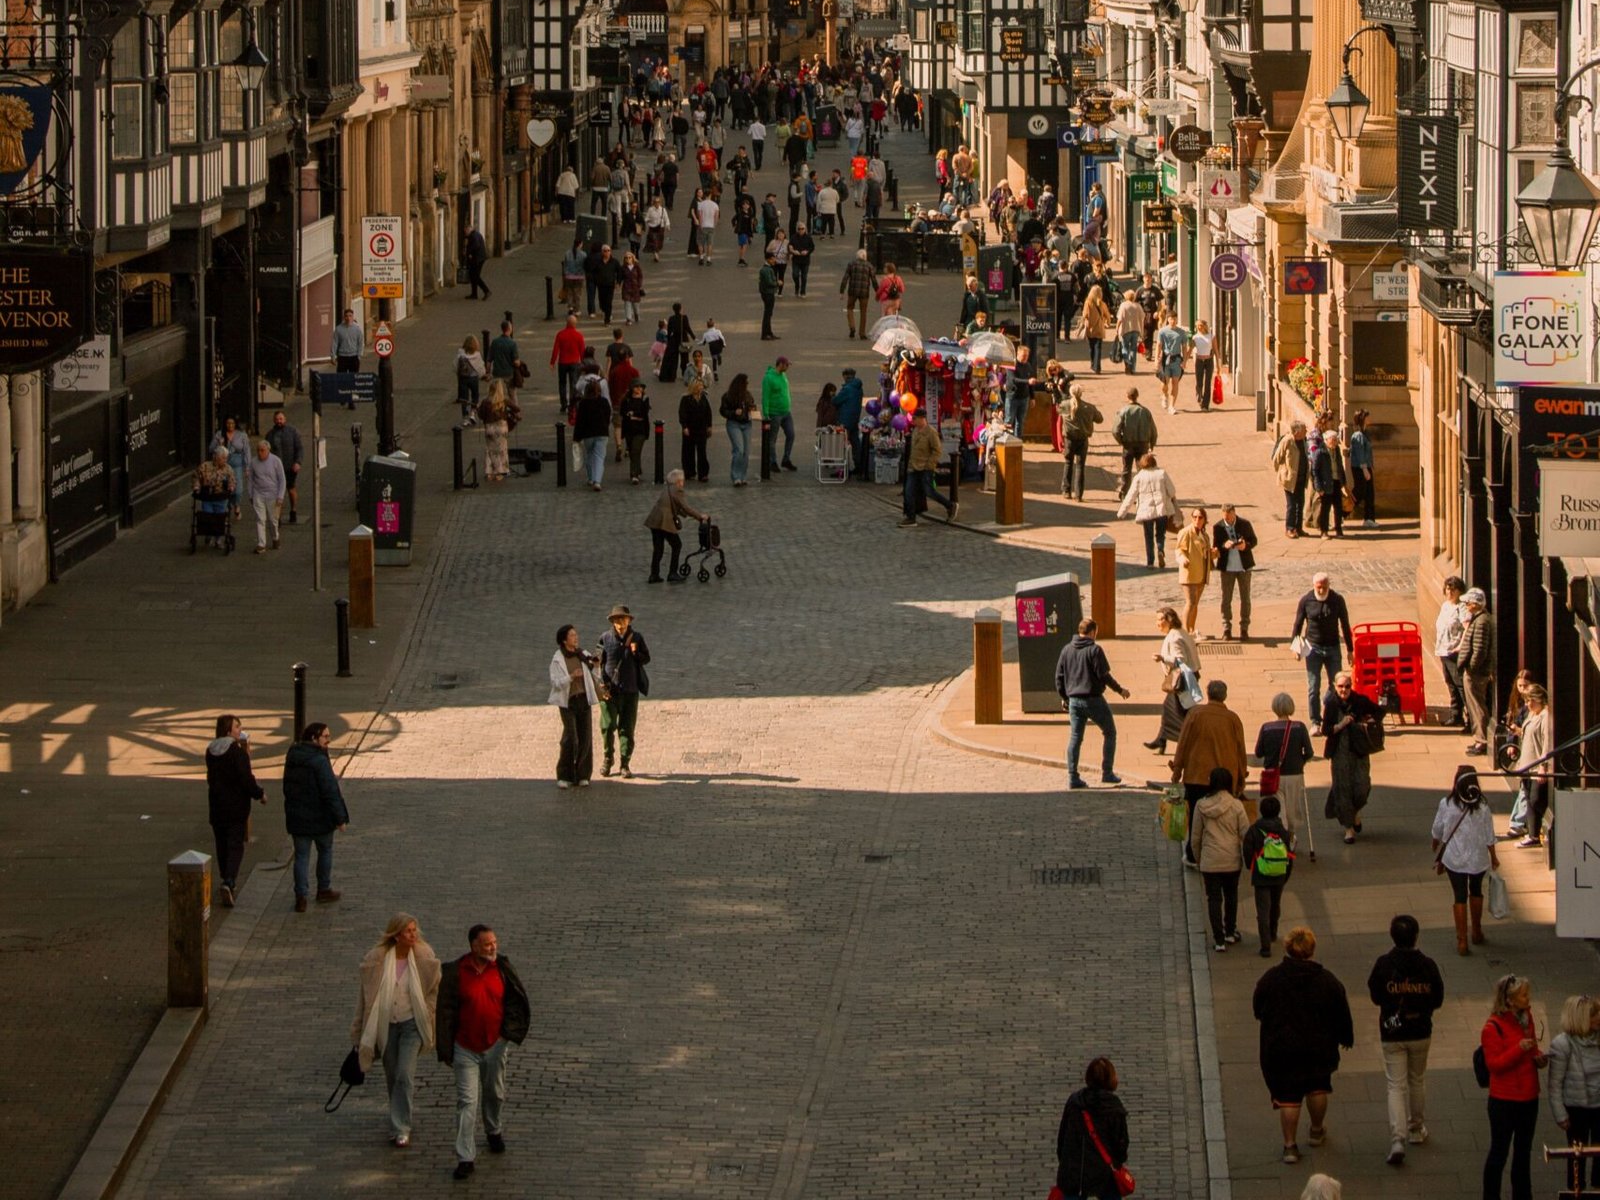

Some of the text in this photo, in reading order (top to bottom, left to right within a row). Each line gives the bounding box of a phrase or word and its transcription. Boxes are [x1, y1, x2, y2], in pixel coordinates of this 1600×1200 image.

[1177, 132, 1200, 141] Bella
[1419, 125, 1438, 220] NEXT
[0, 267, 30, 284] HE
[1221, 262, 1238, 280] B
[1512, 315, 1569, 330] FONE
[0, 339, 29, 347] ISHED
[378, 343, 392, 352] 20
[1497, 334, 1583, 349] GALAXY
